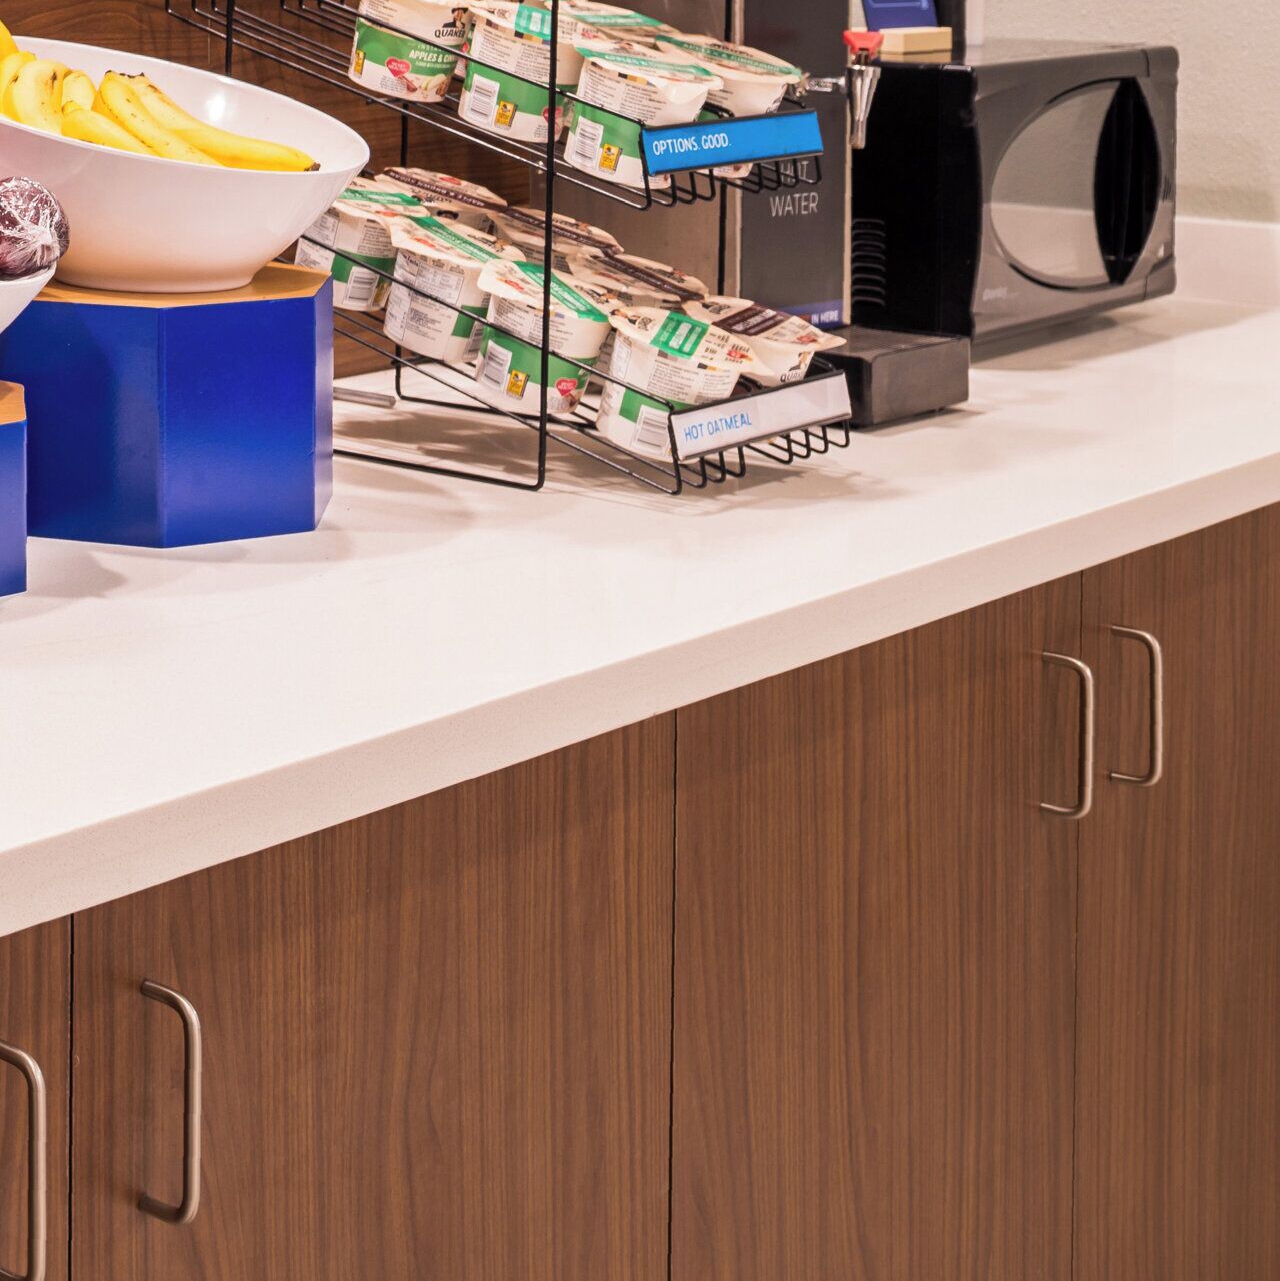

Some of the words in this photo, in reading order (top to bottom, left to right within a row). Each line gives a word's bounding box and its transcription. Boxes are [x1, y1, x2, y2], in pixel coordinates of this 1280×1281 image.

[408, 49, 438, 62] APPLES
[653, 137, 699, 156] OPTIONS.
[701, 132, 732, 150] GOOD.
[770, 192, 819, 217] WATER
[684, 422, 705, 440] HOT
[707, 412, 752, 435] OATMEAL
